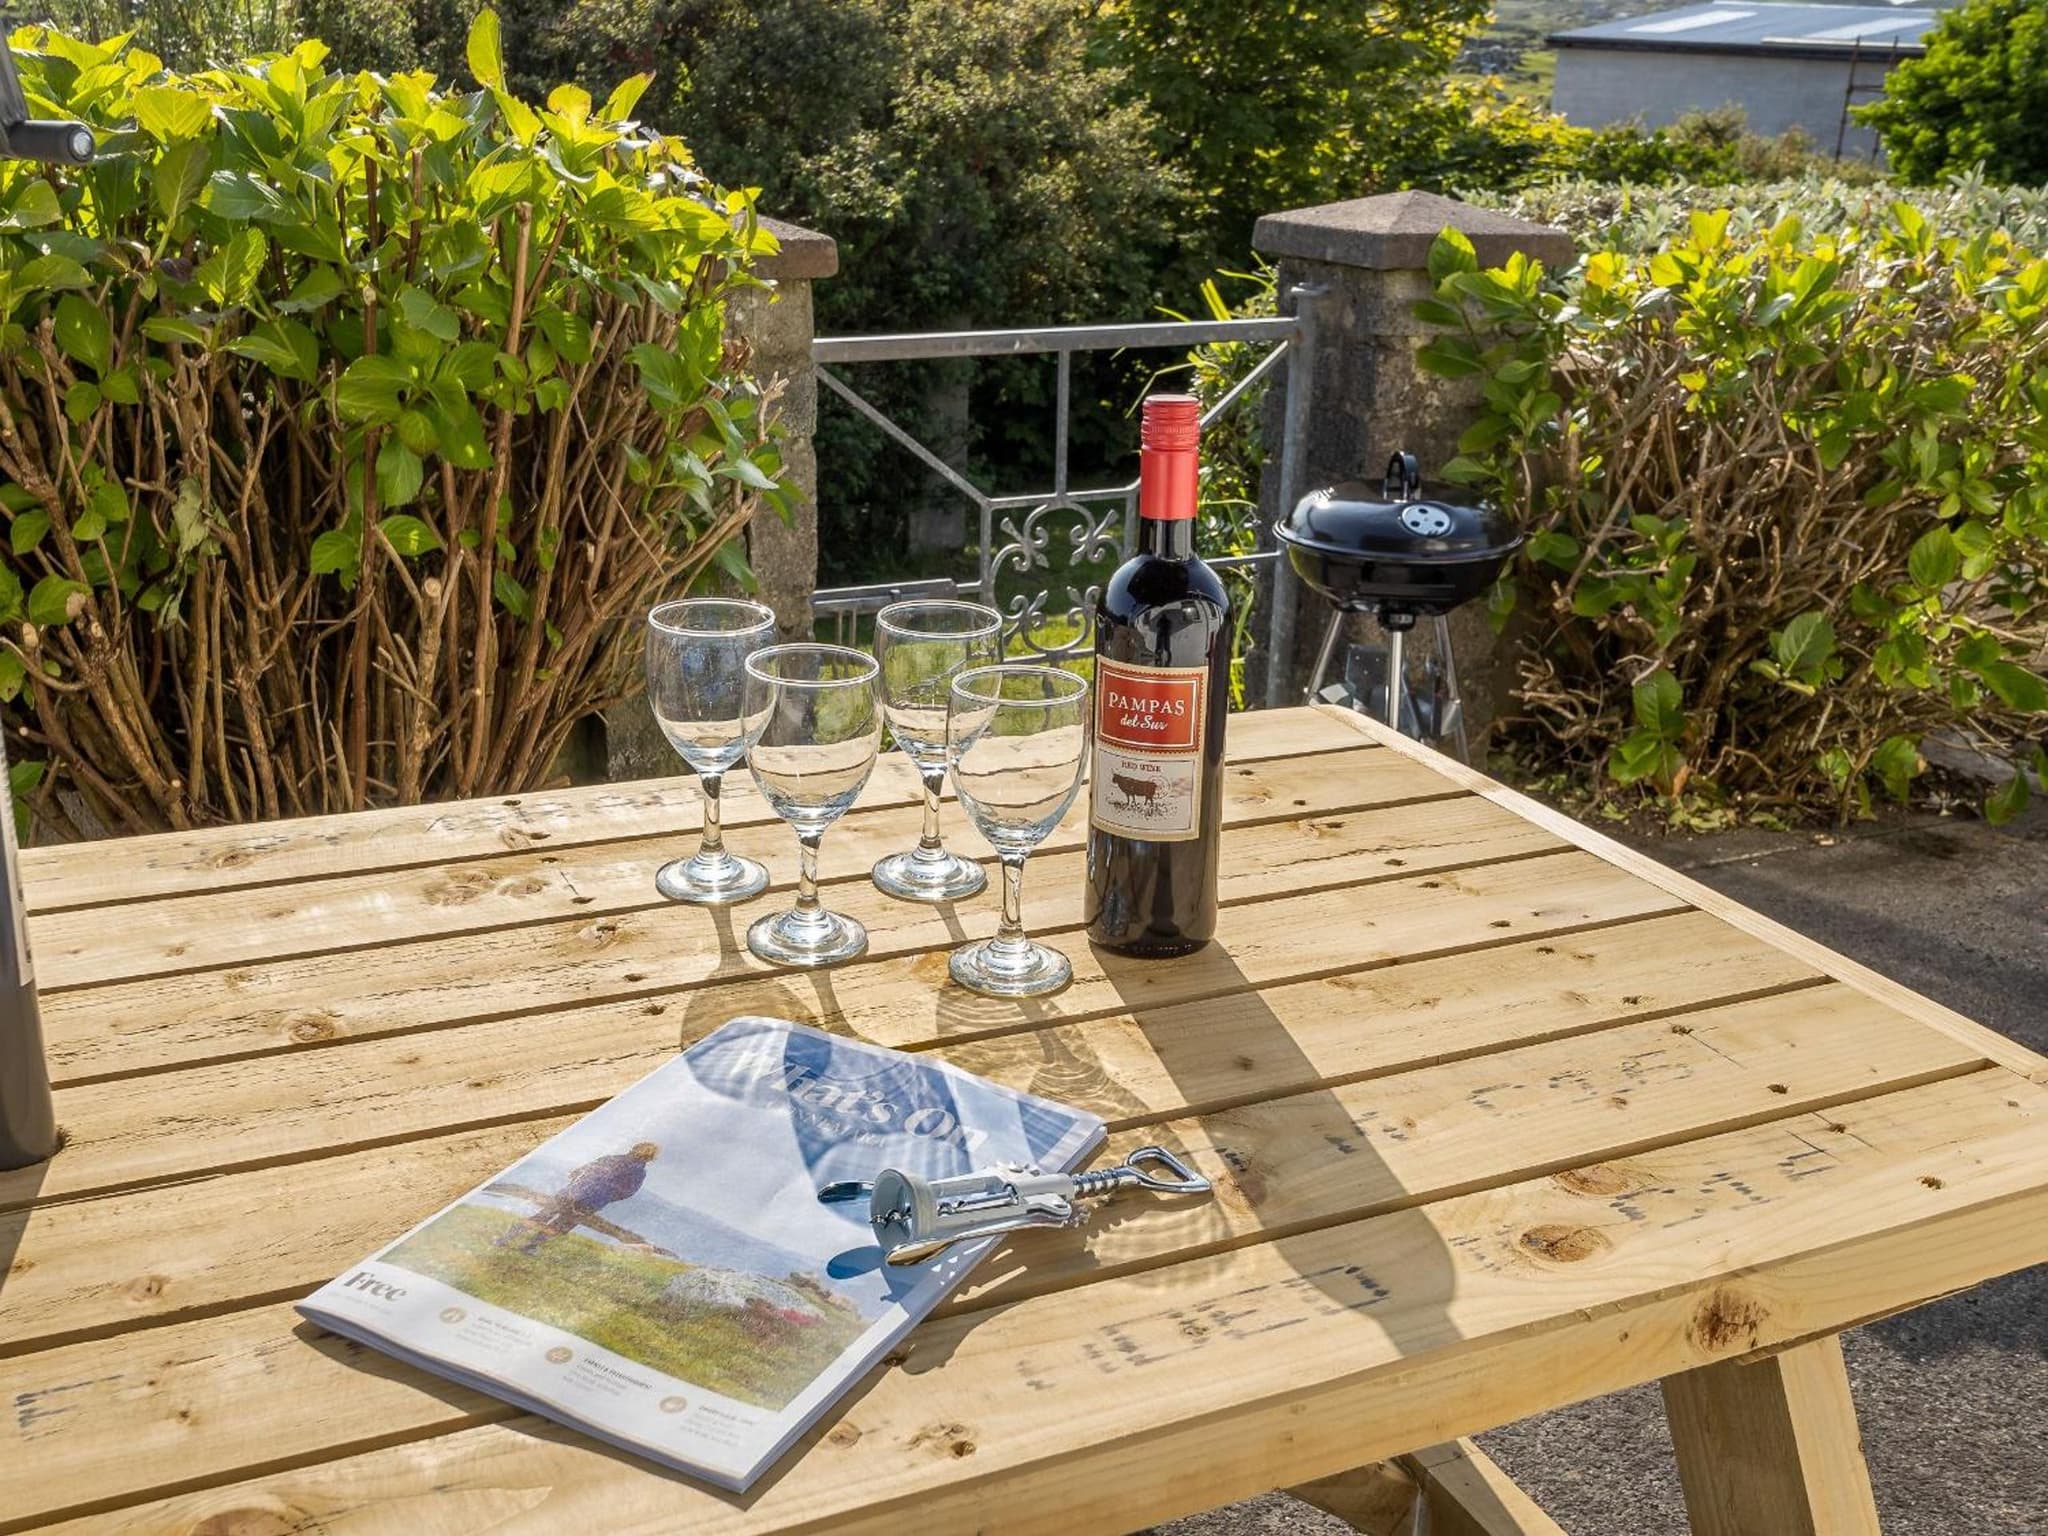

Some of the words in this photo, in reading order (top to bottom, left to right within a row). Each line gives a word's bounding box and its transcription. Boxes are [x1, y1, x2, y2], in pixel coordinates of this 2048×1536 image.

[1108, 691, 1186, 717] PAMPAS
[1120, 713, 1139, 728] del
[1140, 714, 1168, 730] Sur
[343, 1271, 408, 1302] Free
